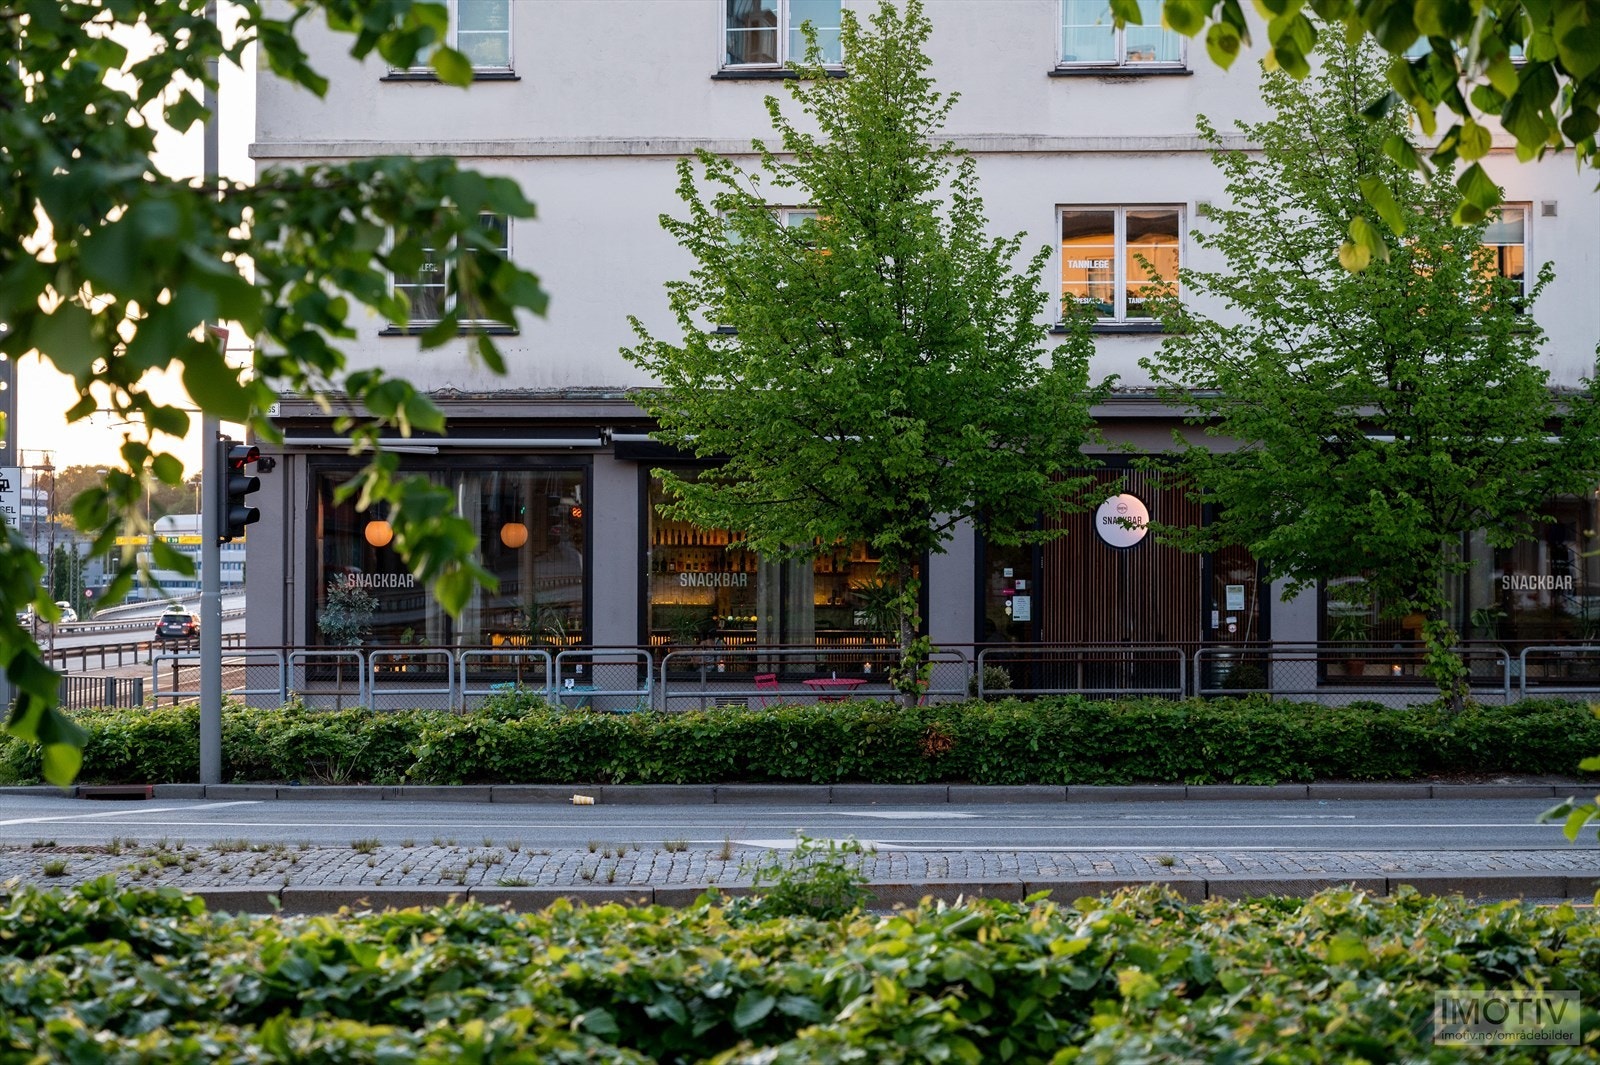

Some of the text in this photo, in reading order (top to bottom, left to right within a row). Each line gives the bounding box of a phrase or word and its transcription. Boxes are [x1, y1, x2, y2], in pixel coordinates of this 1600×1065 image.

[1067, 259, 1110, 269] TANNLEGE
[348, 573, 415, 588] SNACKBAR
[680, 572, 747, 587] SNACKBAR
[1502, 575, 1573, 590] SNACKBAR
